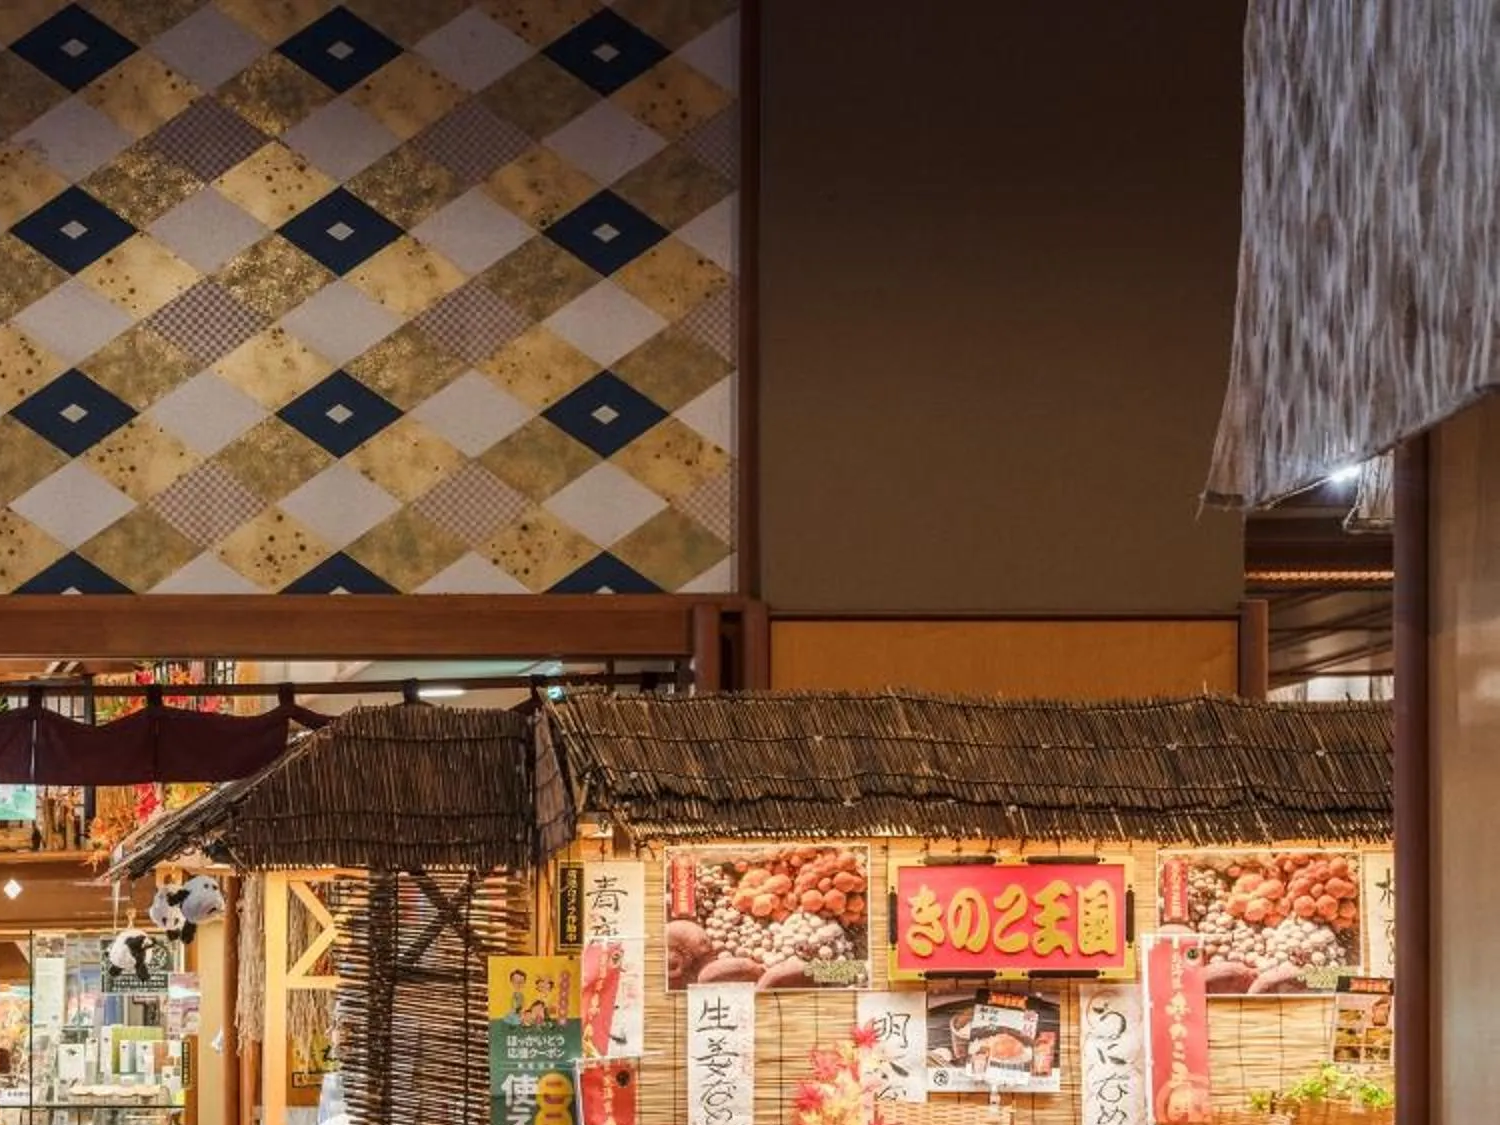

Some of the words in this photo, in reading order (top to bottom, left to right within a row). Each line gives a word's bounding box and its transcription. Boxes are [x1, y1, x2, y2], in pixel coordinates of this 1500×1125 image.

[906, 879, 1117, 958] きのこ王国
[506, 1035, 566, 1047] ほっかいどう
